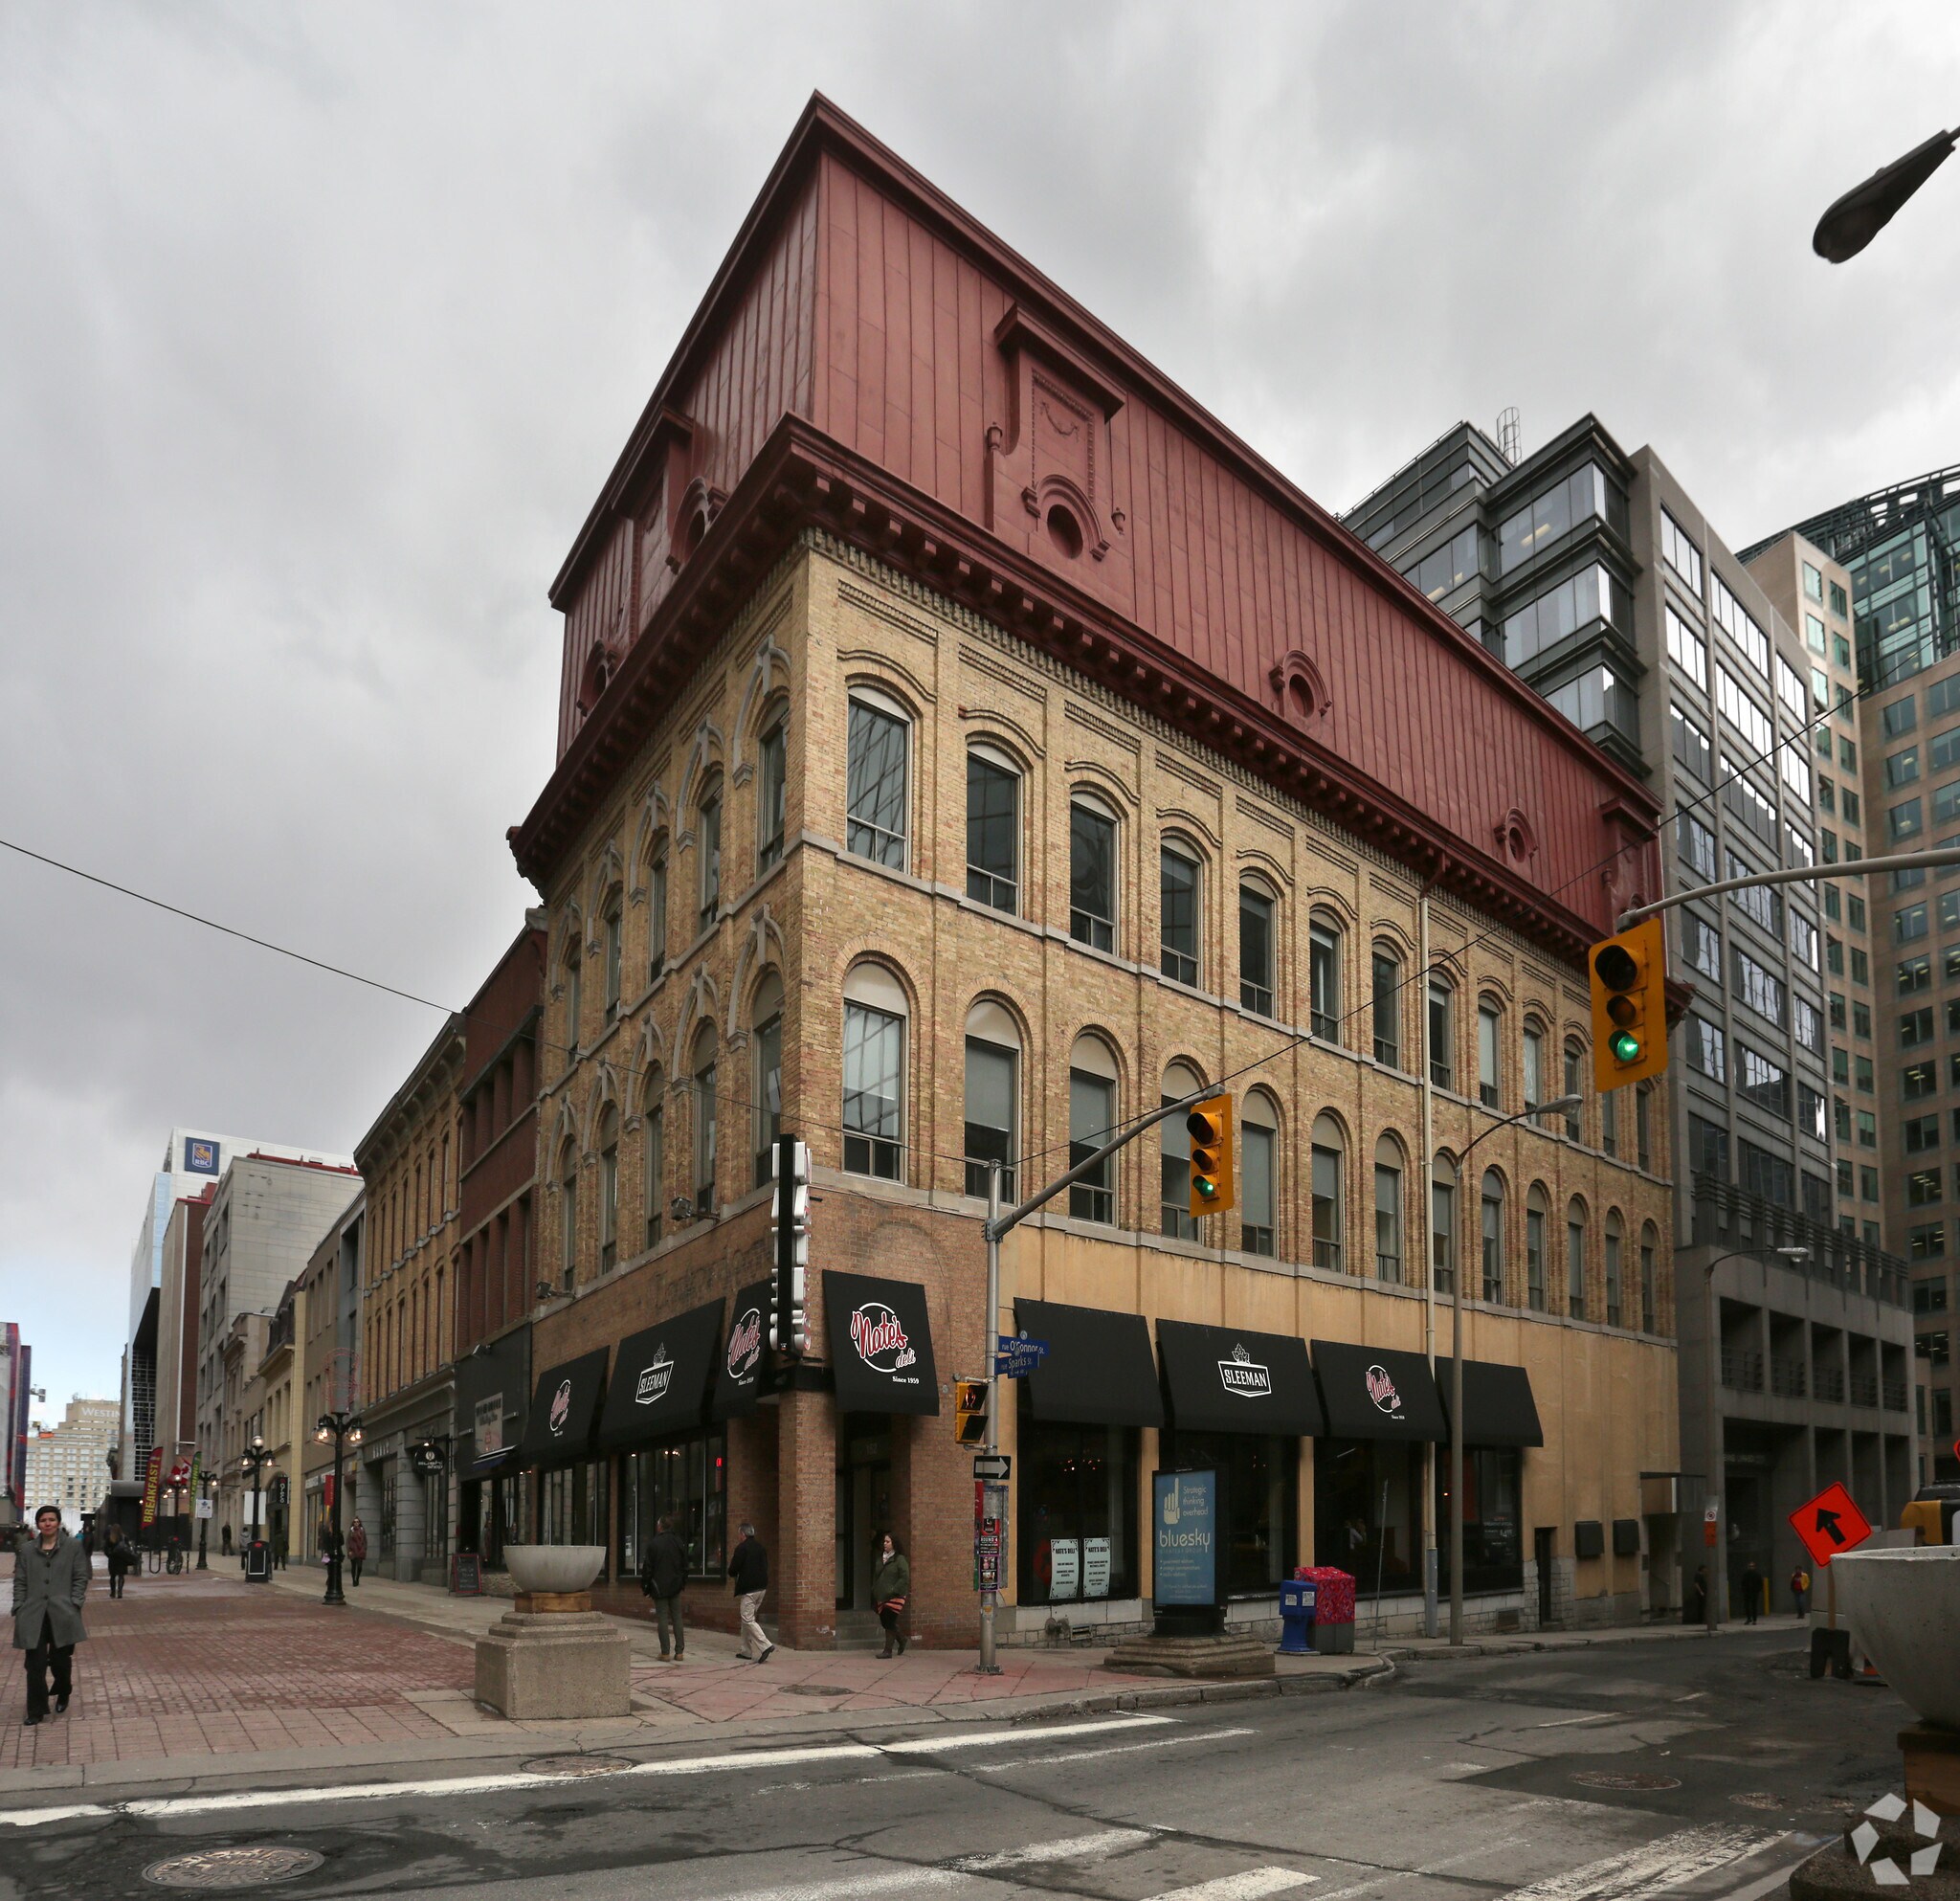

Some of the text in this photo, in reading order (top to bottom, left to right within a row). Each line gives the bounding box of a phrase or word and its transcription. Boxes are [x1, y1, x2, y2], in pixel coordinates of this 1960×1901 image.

[194, 1158, 210, 1167] RBC
[850, 1310, 909, 1359] Nate's
[895, 1347, 917, 1369] deli
[1008, 1355, 1027, 1370] Sparks
[638, 1370, 670, 1395] SLEEMAN
[892, 1375, 920, 1385] Since 1959
[1223, 1369, 1268, 1387] SLEEMAN
[143, 1463, 161, 1524] BREAKFAST
[1183, 1486, 1207, 1495] Strategic
[1183, 1496, 1205, 1507] thinking
[1183, 1507, 1209, 1516] overhead
[1159, 1528, 1211, 1554] bluesky
